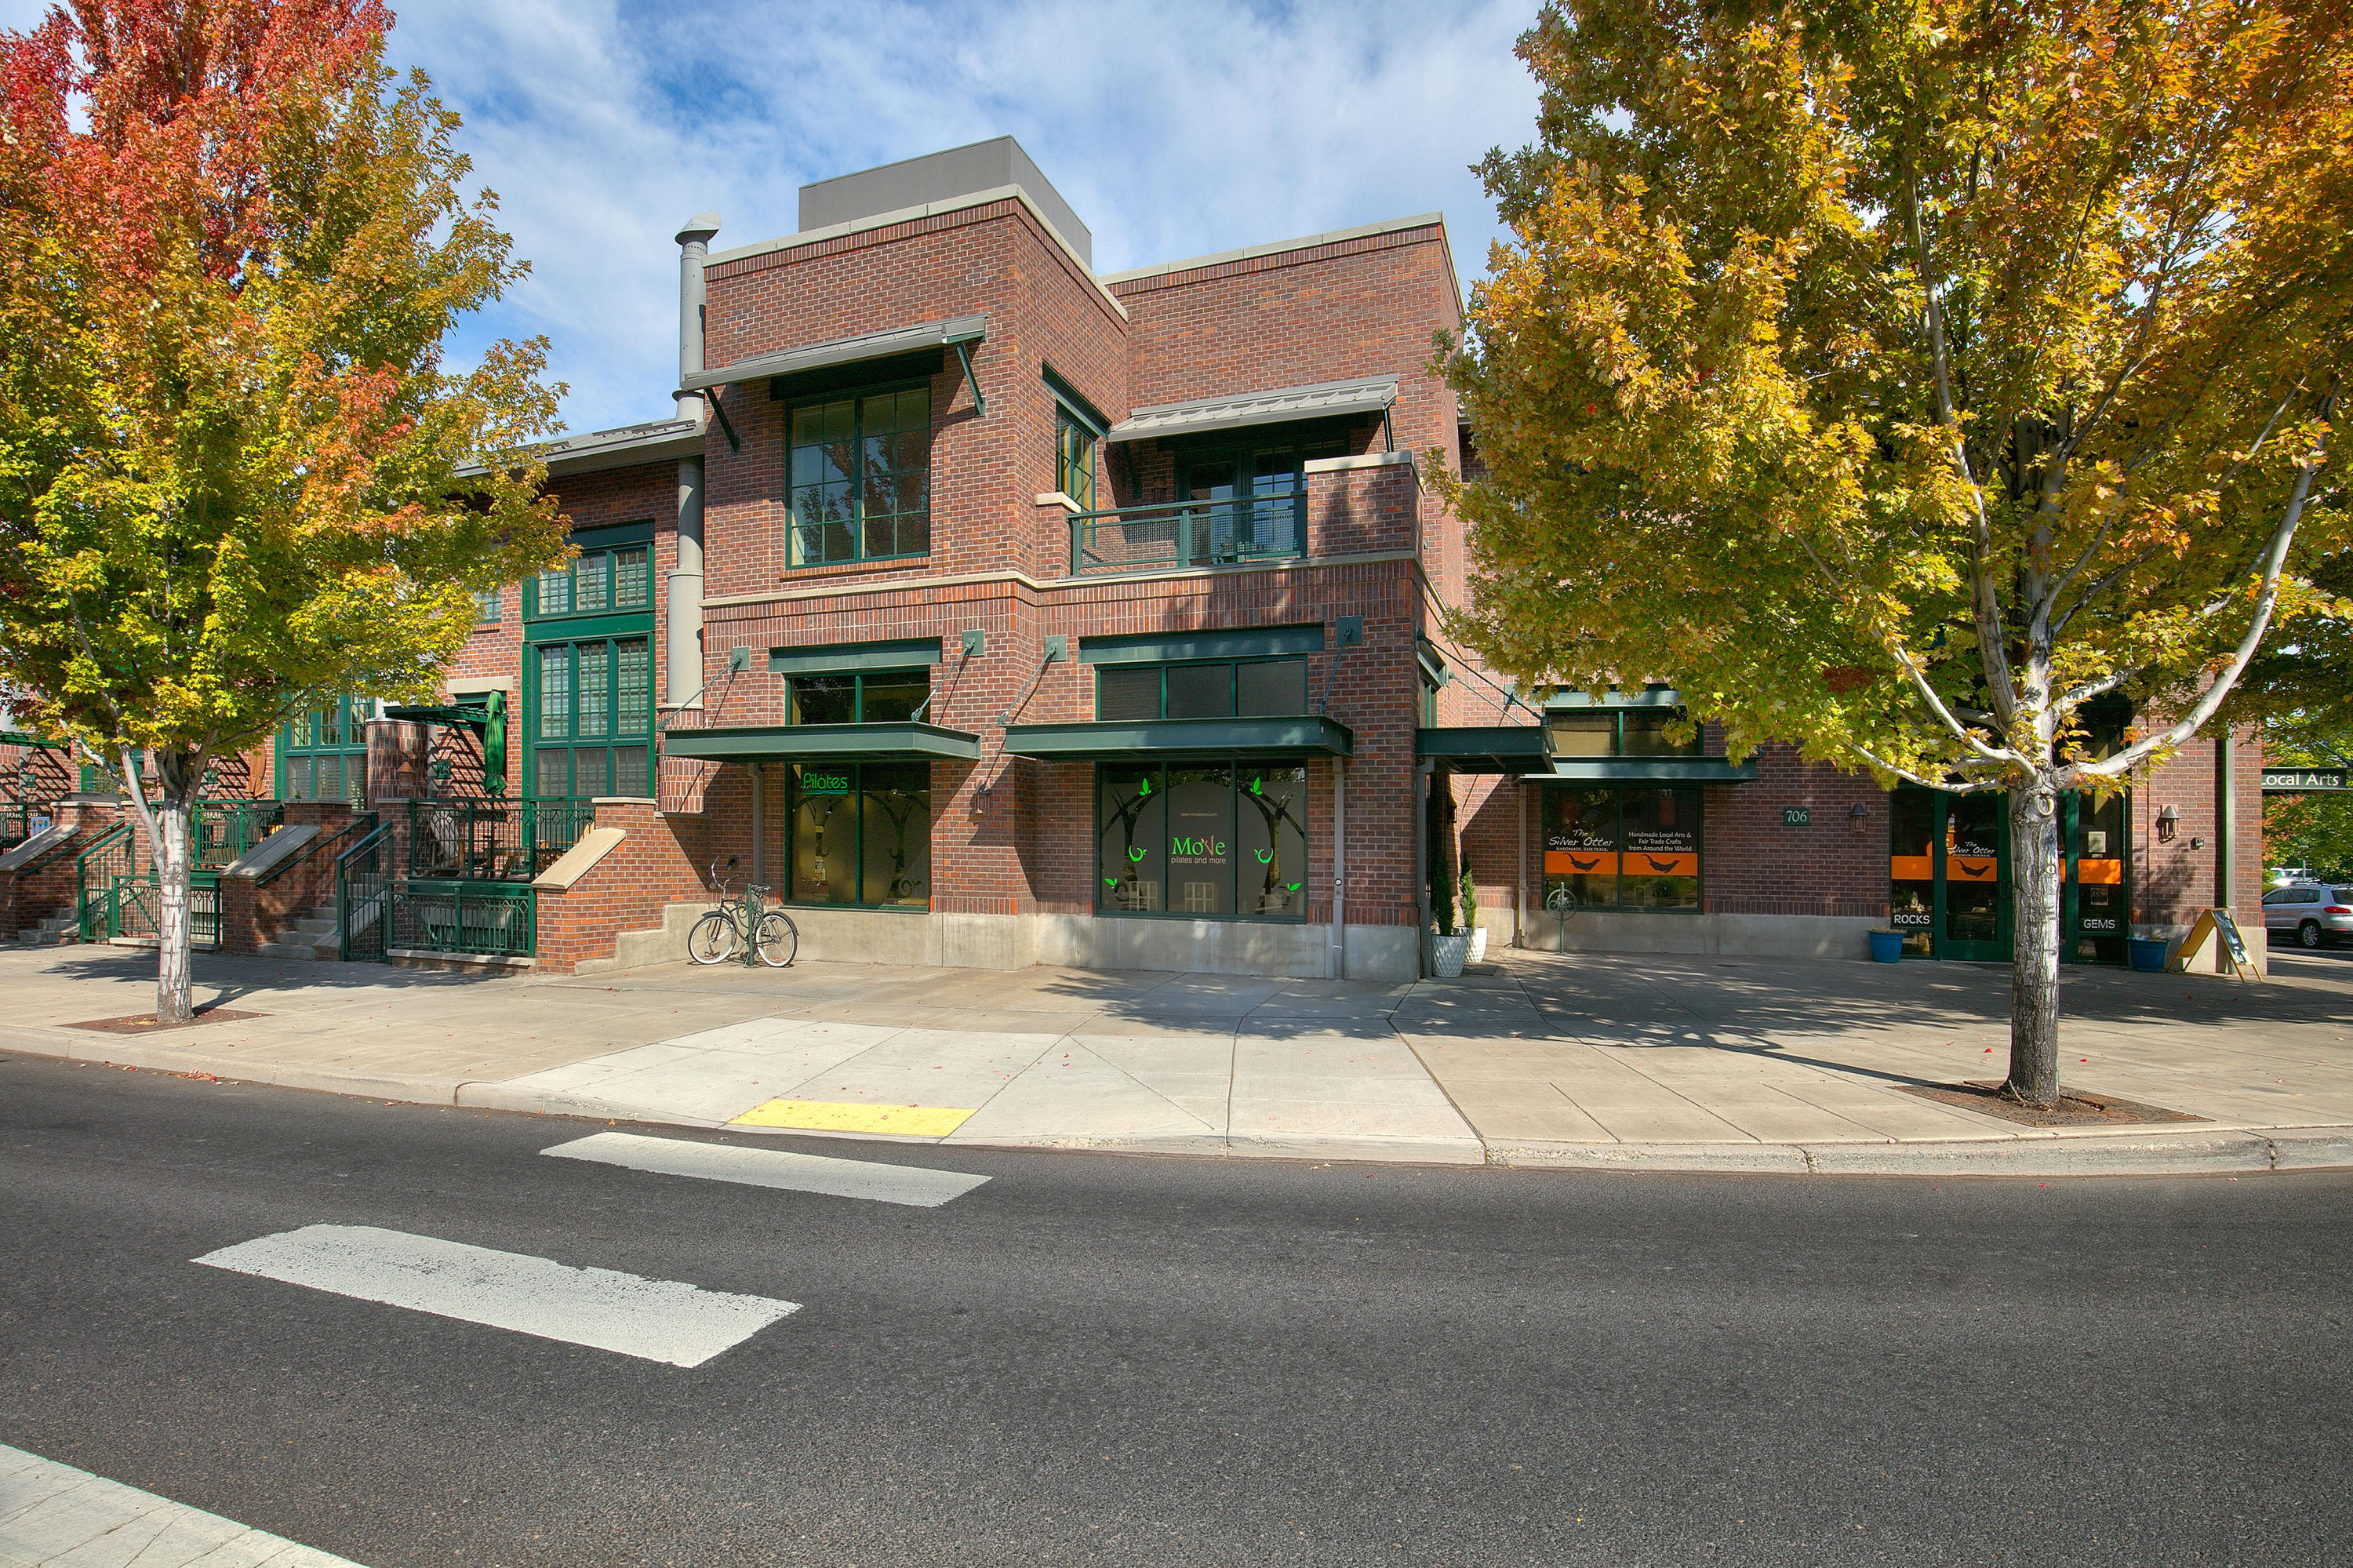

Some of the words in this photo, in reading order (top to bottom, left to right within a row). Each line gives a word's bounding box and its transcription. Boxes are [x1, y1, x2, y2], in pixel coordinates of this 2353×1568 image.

[803, 773, 848, 789] Pilates
[2305, 772, 2340, 786] Arts
[1786, 810, 1808, 822] 706
[1573, 828, 1588, 837] The
[1548, 836, 1579, 846] Silver
[1583, 836, 1614, 846] Otter
[1894, 914, 1930, 925] ROCKS
[2083, 919, 2115, 929] GEMS
